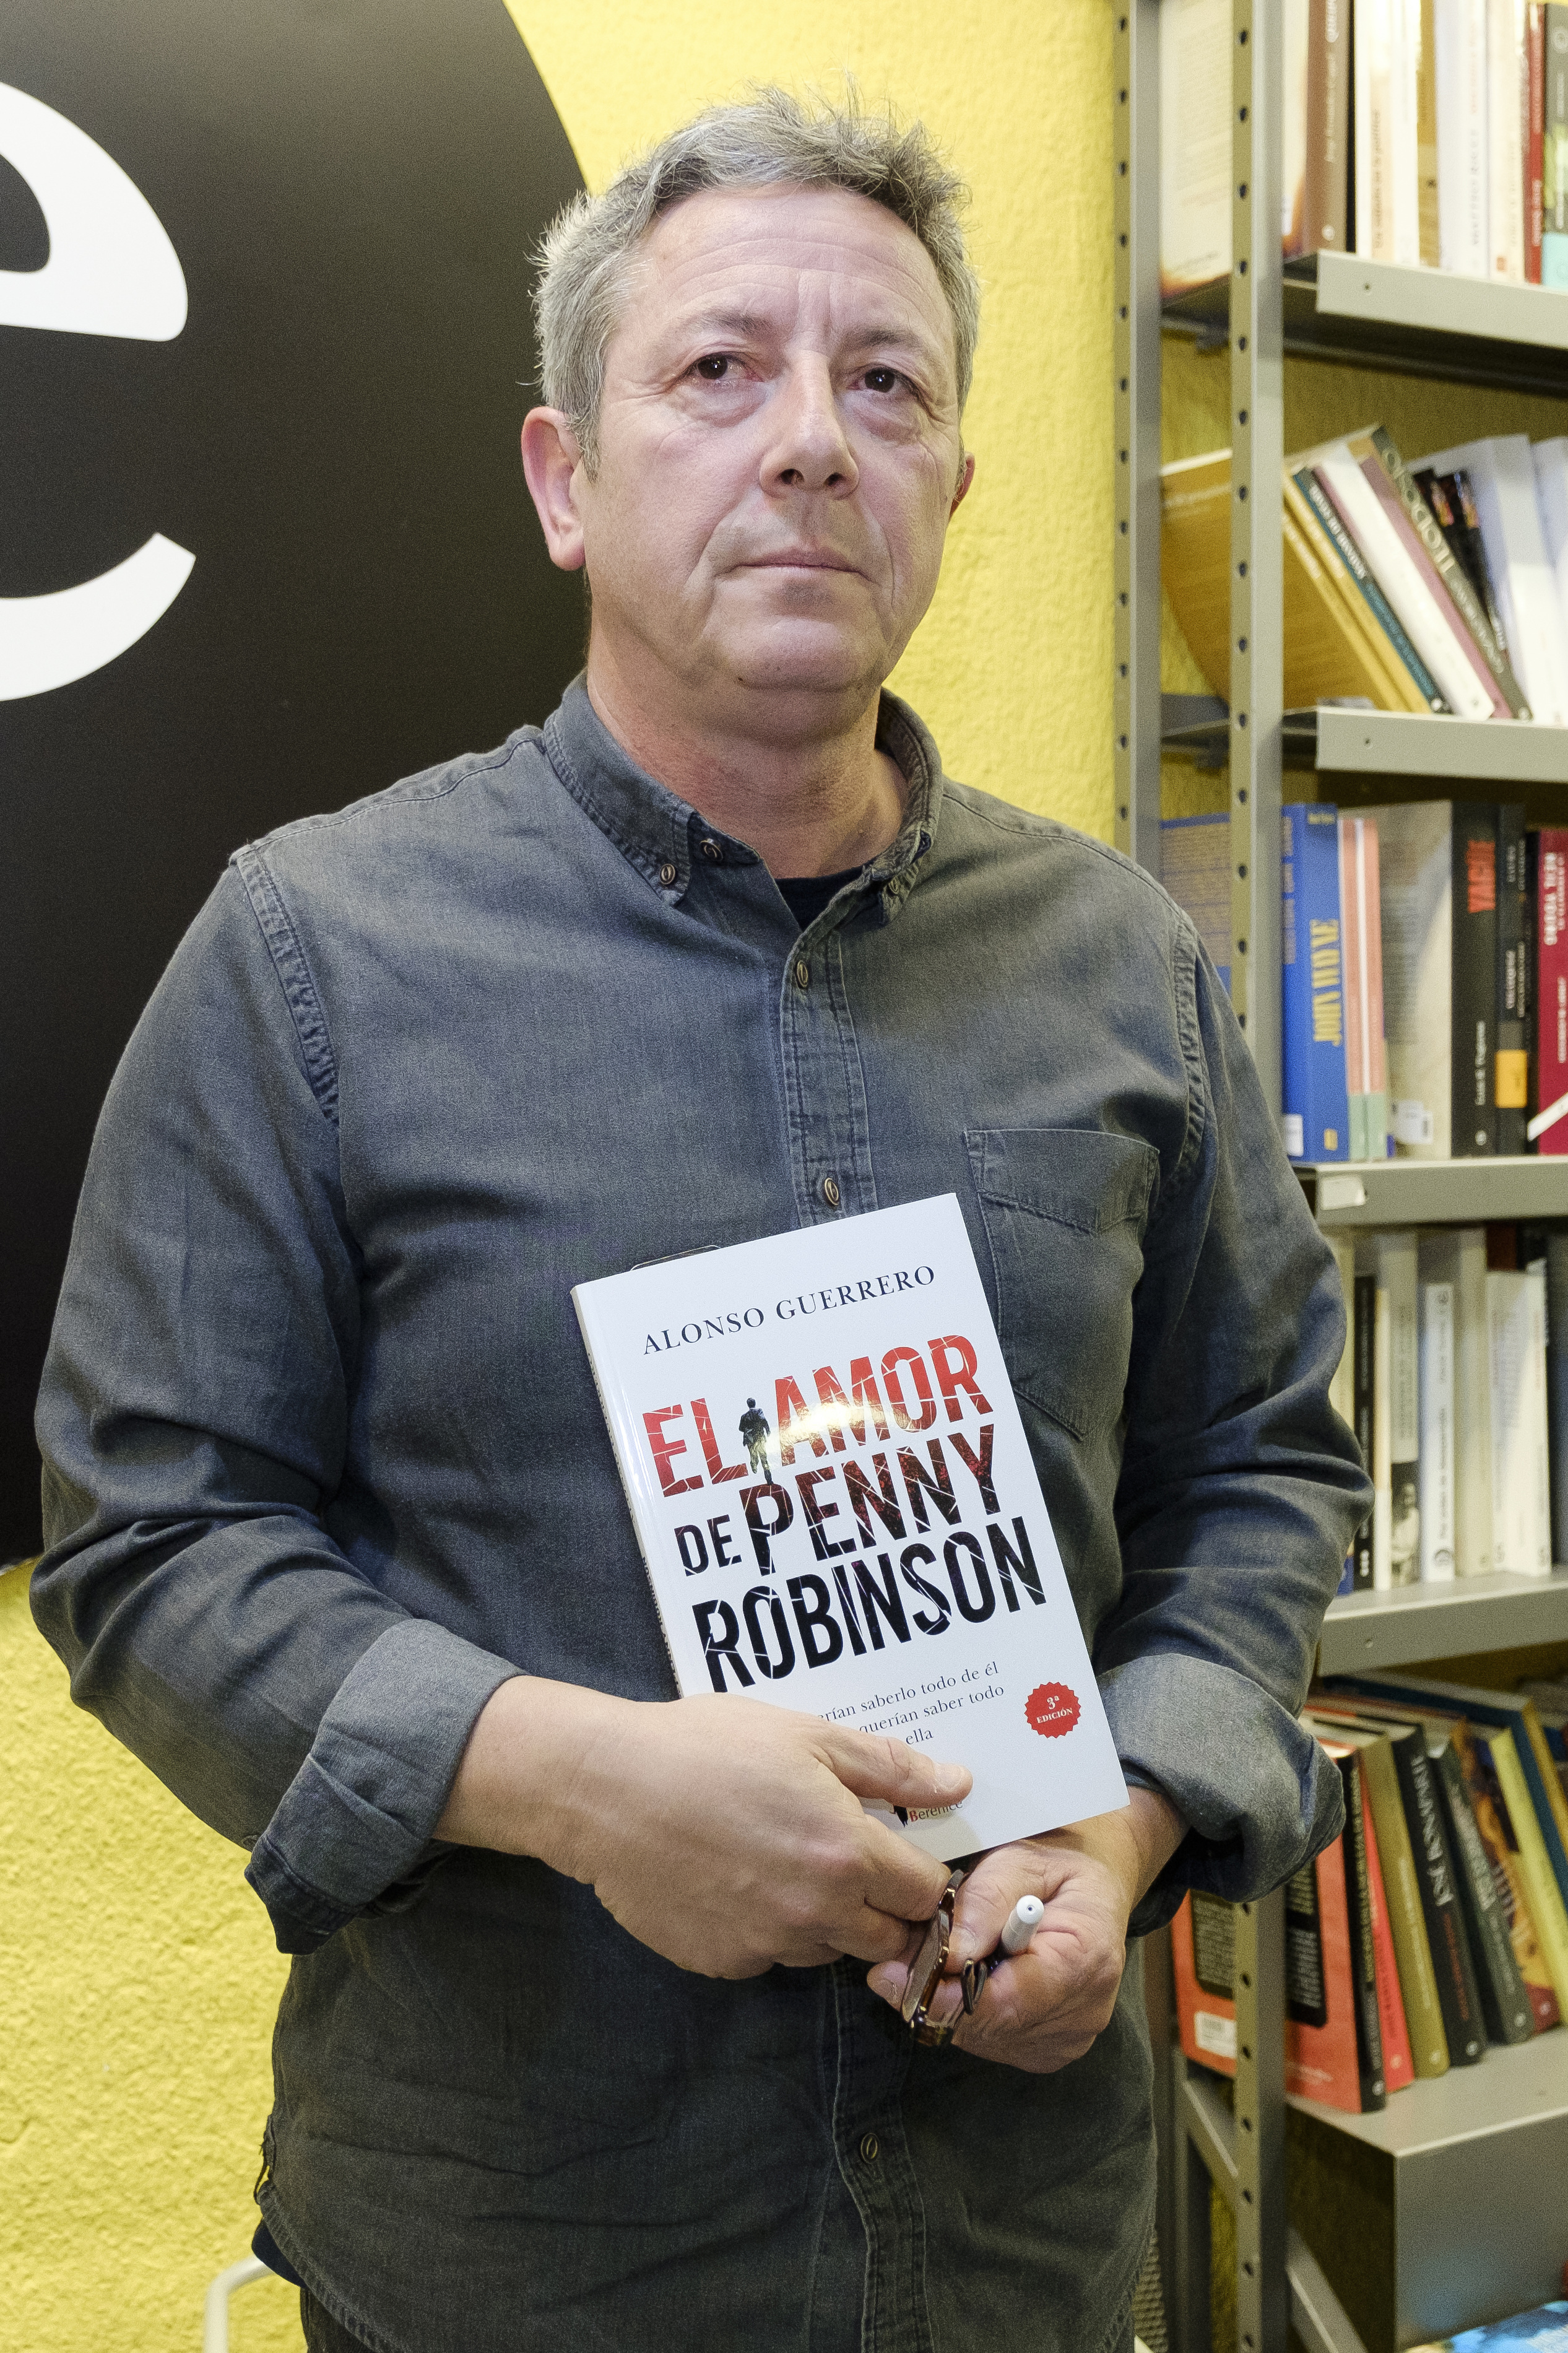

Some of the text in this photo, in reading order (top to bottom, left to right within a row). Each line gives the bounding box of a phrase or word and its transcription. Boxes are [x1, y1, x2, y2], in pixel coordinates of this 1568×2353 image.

[644, 1266, 935, 1355] ALONSO GUERRERO
[643, 1398, 748, 1497] EL
[775, 1334, 994, 1466] AMOR
[674, 1514, 742, 1577] DE
[740, 1423, 1000, 1577] PENNY
[691, 1515, 1047, 1692] ROBINSON
[861, 1687, 916, 1712] saberlo
[921, 1676, 956, 1694] todo
[961, 1669, 980, 1683] de
[985, 1661, 1000, 1676] él
[924, 1696, 964, 1717] saber
[969, 1685, 1004, 1703] todo
[1047, 1695, 1060, 1710] 3ª
[906, 1728, 934, 1745] ella
[1036, 1707, 1074, 1724] EDICIÓN
